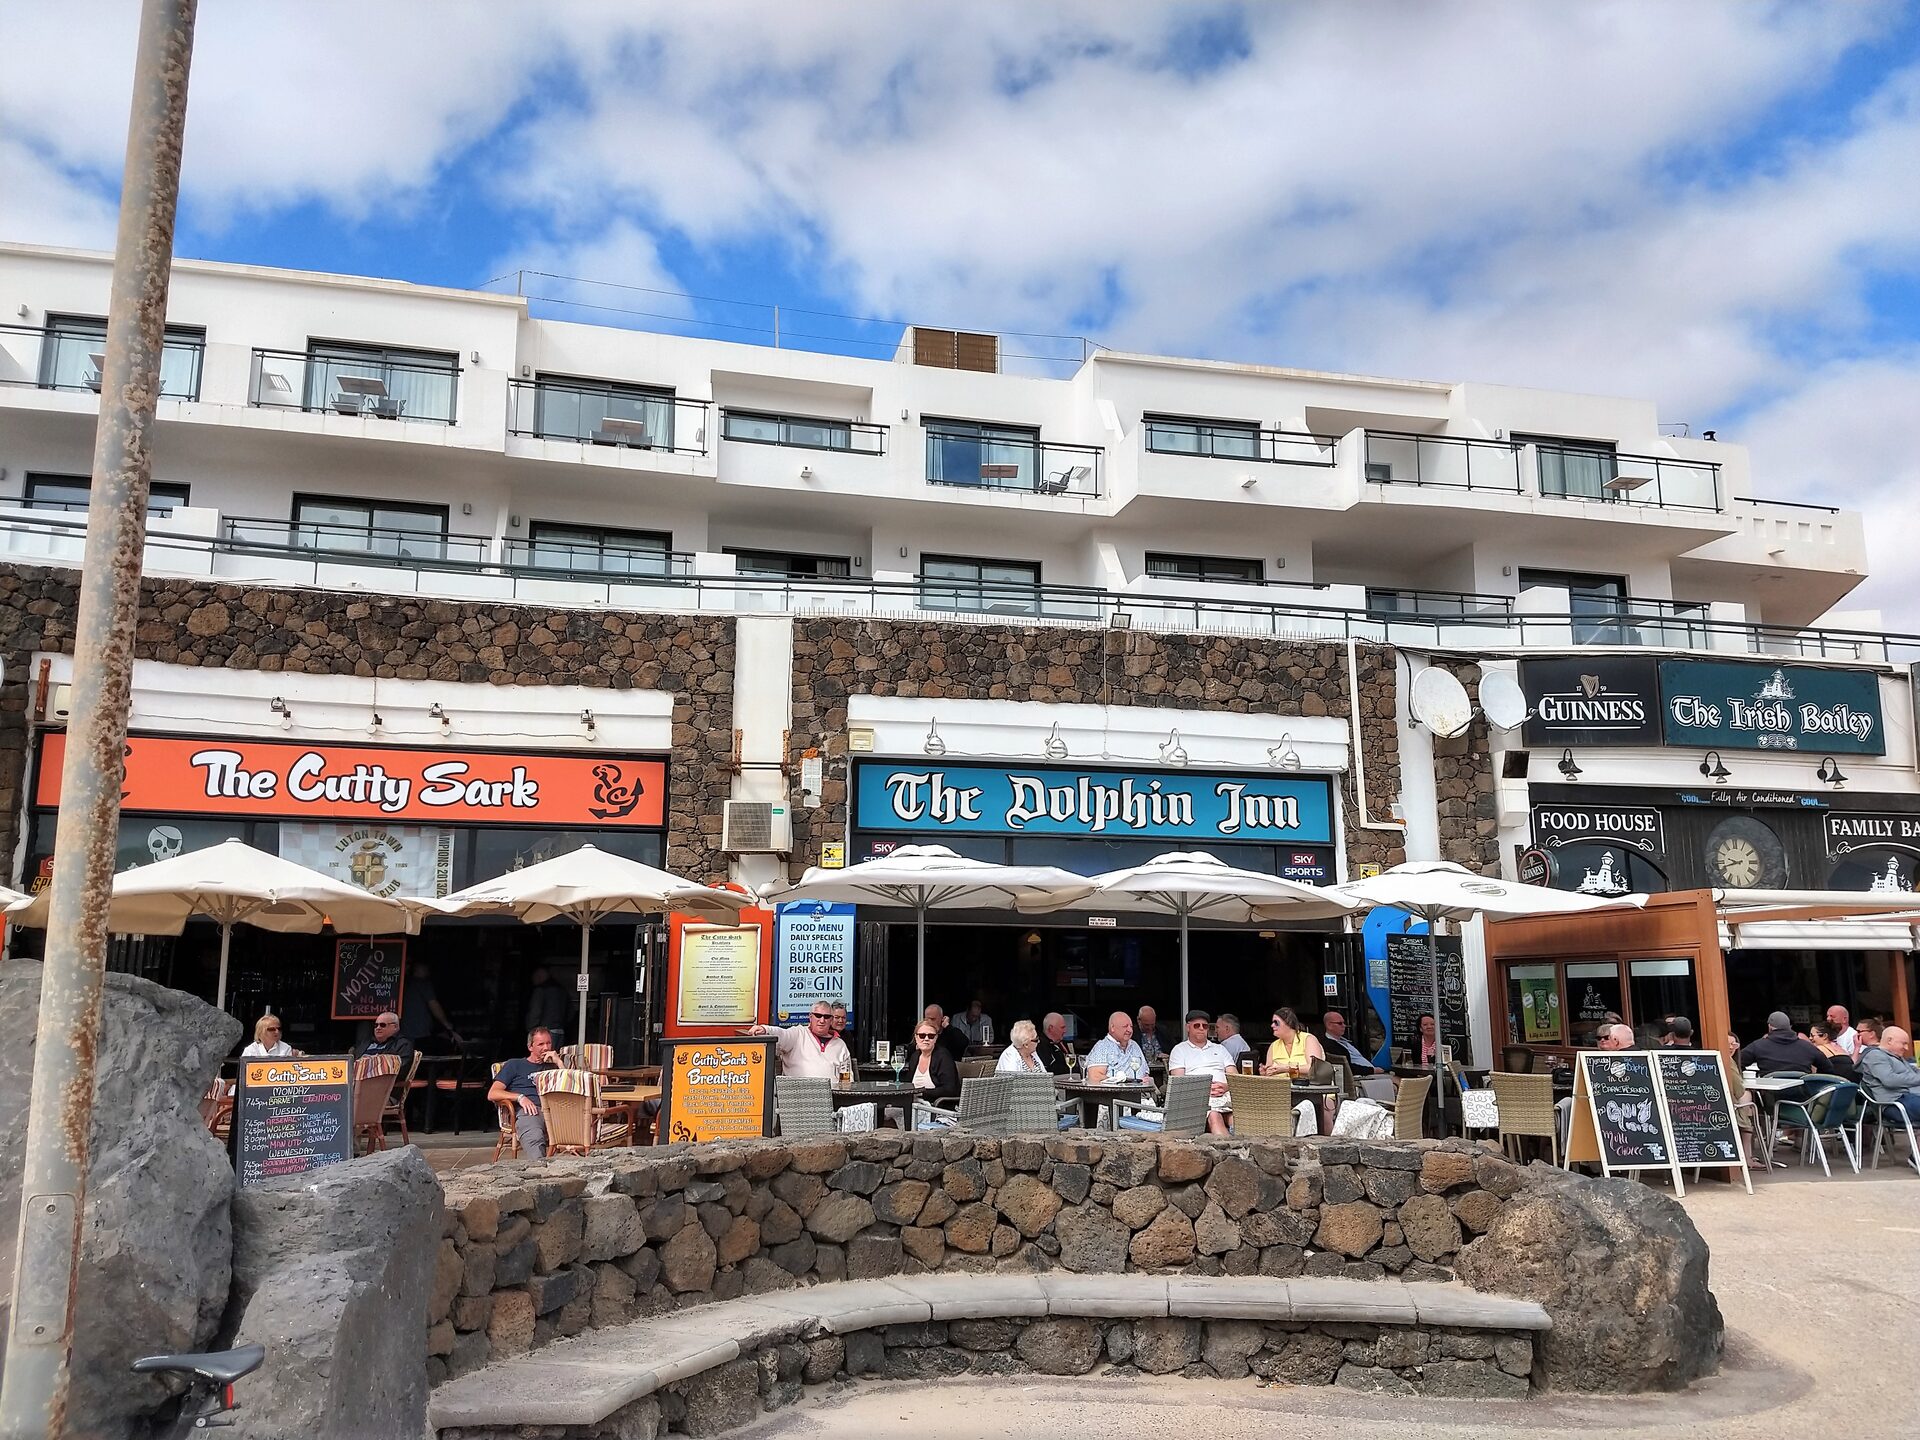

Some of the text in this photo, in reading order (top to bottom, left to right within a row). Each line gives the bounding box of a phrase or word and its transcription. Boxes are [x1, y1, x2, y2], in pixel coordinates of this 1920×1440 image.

[1539, 697, 1645, 721] GUINNESS
[1671, 695, 1874, 741] The Irish Bailey
[191, 751, 540, 813] The Cutty Sark
[886, 772, 1301, 834] The Dolphin Inn
[1711, 790, 1796, 806] Fully Air Conditioned
[1540, 812, 1656, 832] FOOD HOUSE
[1830, 819, 1894, 837] FAMILY
[335, 829, 403, 853] LUTON TOWN
[874, 843, 895, 852] SKY
[1294, 855, 1314, 864] SKY
[1284, 867, 1324, 876] SPORTS
[1522, 864, 1545, 880] GUINNESS
[379, 879, 401, 899] CLUB
[790, 923, 844, 932] FOOD MENU
[790, 943, 843, 951] GOURMET
[790, 952, 843, 963] BURGERS
[340, 950, 384, 1003] MOJITO
[382, 967, 400, 975] FRESH
[789, 982, 804, 990] 20
[814, 976, 843, 990] GIN
[360, 995, 374, 1003] NO
[692, 1051, 747, 1068] Cutty Sark
[268, 1068, 327, 1083] Cutty Sark
[687, 1068, 750, 1087] Breakfast
[273, 1087, 310, 1096] MONDAY
[268, 1096, 295, 1105] BARNET
[266, 1116, 297, 1125] ARSENAL
[306, 1112, 331, 1120] CARDIFF
[268, 1107, 307, 1116] TUESDAY
[266, 1124, 295, 1133] WOLVES
[302, 1119, 320, 1128] WEST
[310, 1126, 323, 1134] MAN
[324, 1125, 341, 1133] CITY
[270, 1140, 286, 1149] MAN
[287, 1139, 302, 1147] UTD
[269, 1147, 315, 1157] WEDNESDAY
